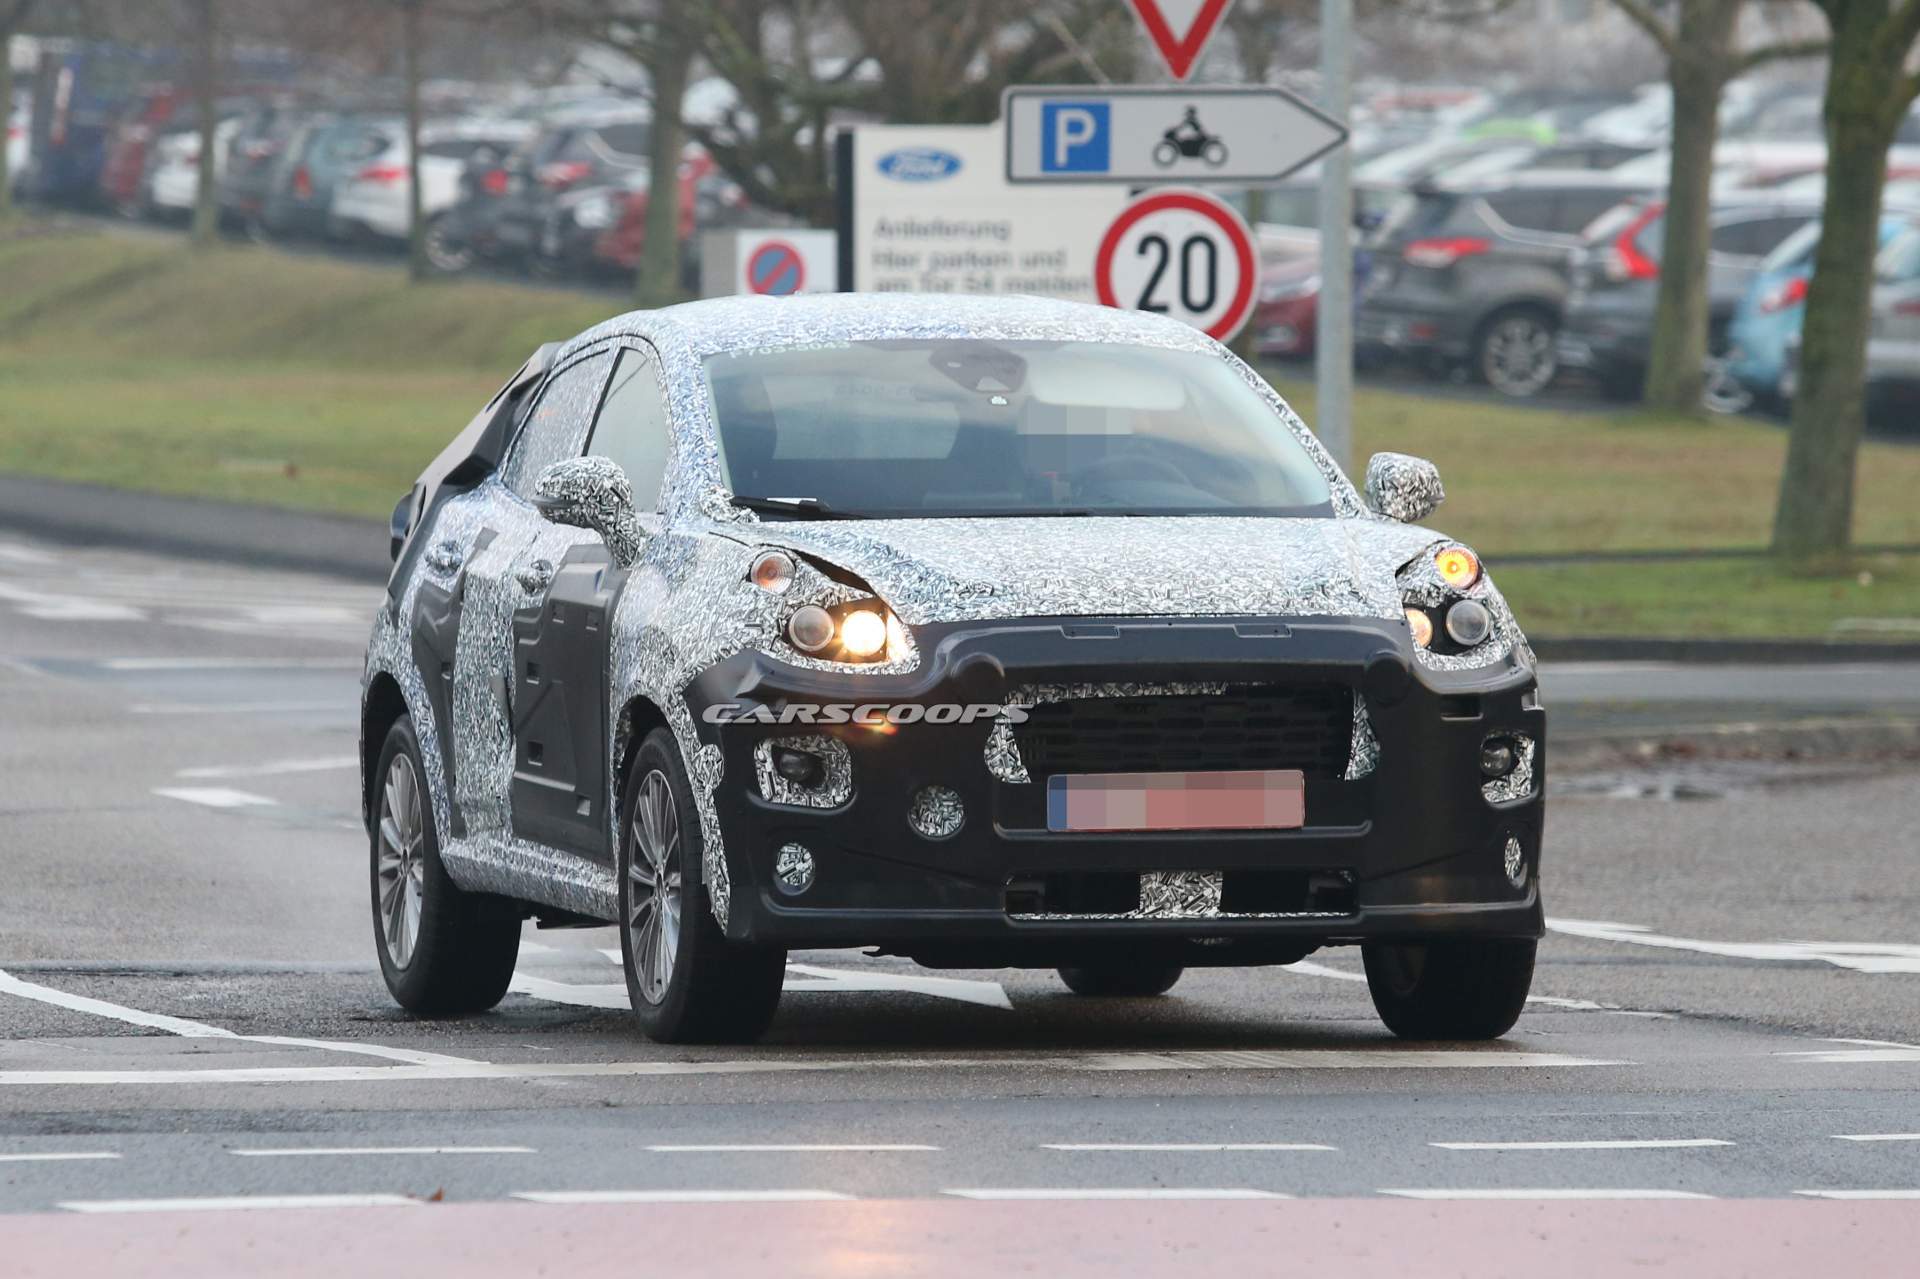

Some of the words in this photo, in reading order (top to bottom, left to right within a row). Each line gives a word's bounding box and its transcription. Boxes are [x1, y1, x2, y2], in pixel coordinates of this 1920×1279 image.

[1055, 108, 1097, 168] P
[874, 217, 1011, 241] Anlieferung
[871, 249, 918, 269] Hier
[929, 249, 1012, 273] parken
[1021, 248, 1067, 270] und
[1136, 232, 1218, 314] 20
